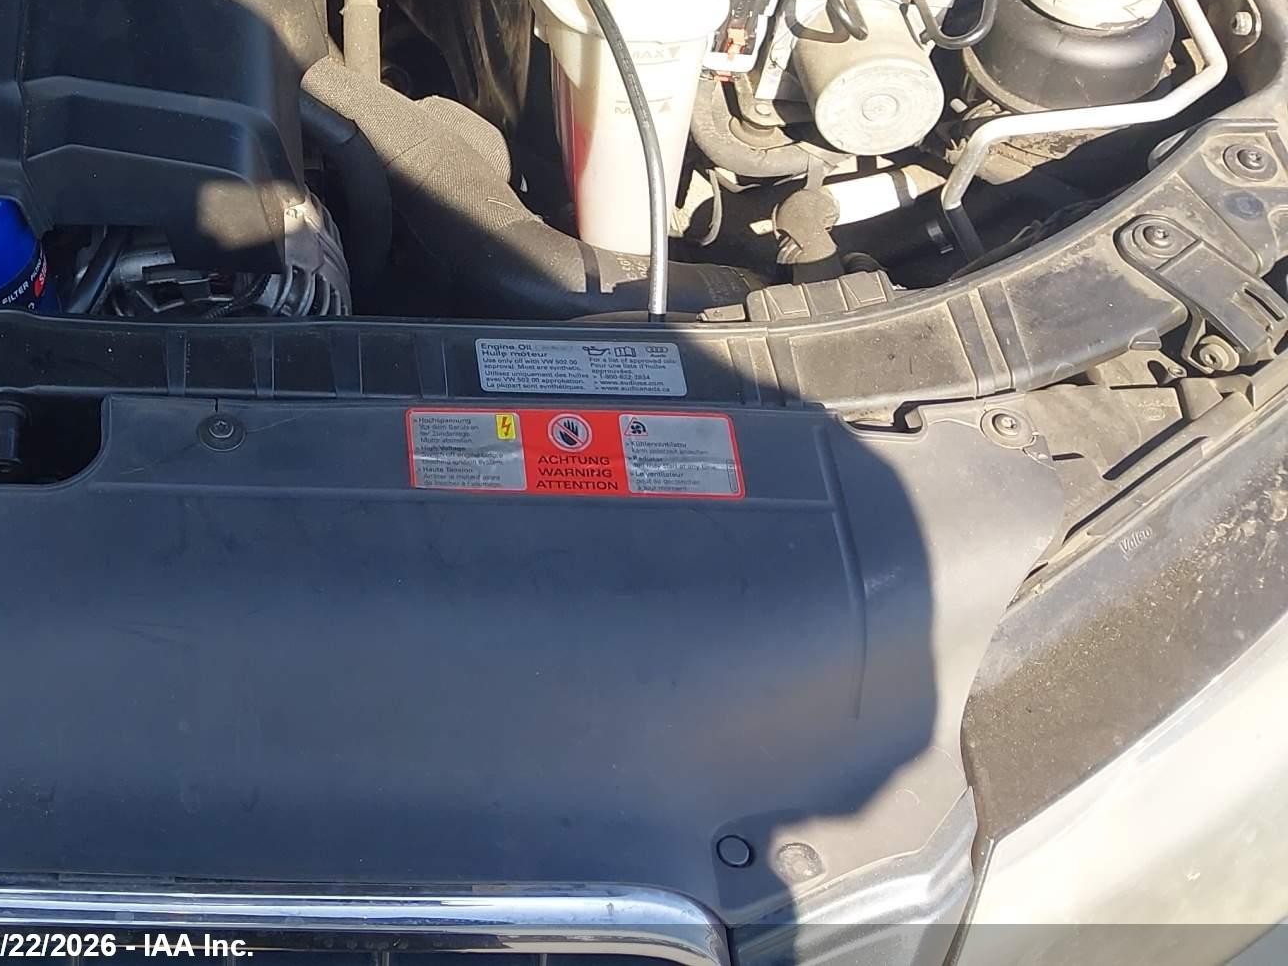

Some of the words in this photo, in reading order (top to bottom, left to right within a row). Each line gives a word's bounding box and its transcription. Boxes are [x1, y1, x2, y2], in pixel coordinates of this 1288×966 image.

[2, 281, 29, 304] FILTER
[481, 343, 515, 352] Engine
[538, 455, 610, 466] ACHTUNG
[538, 467, 613, 478] WARNING
[536, 480, 618, 491] ATTENTION
[1119, 527, 1153, 555] Valeo
